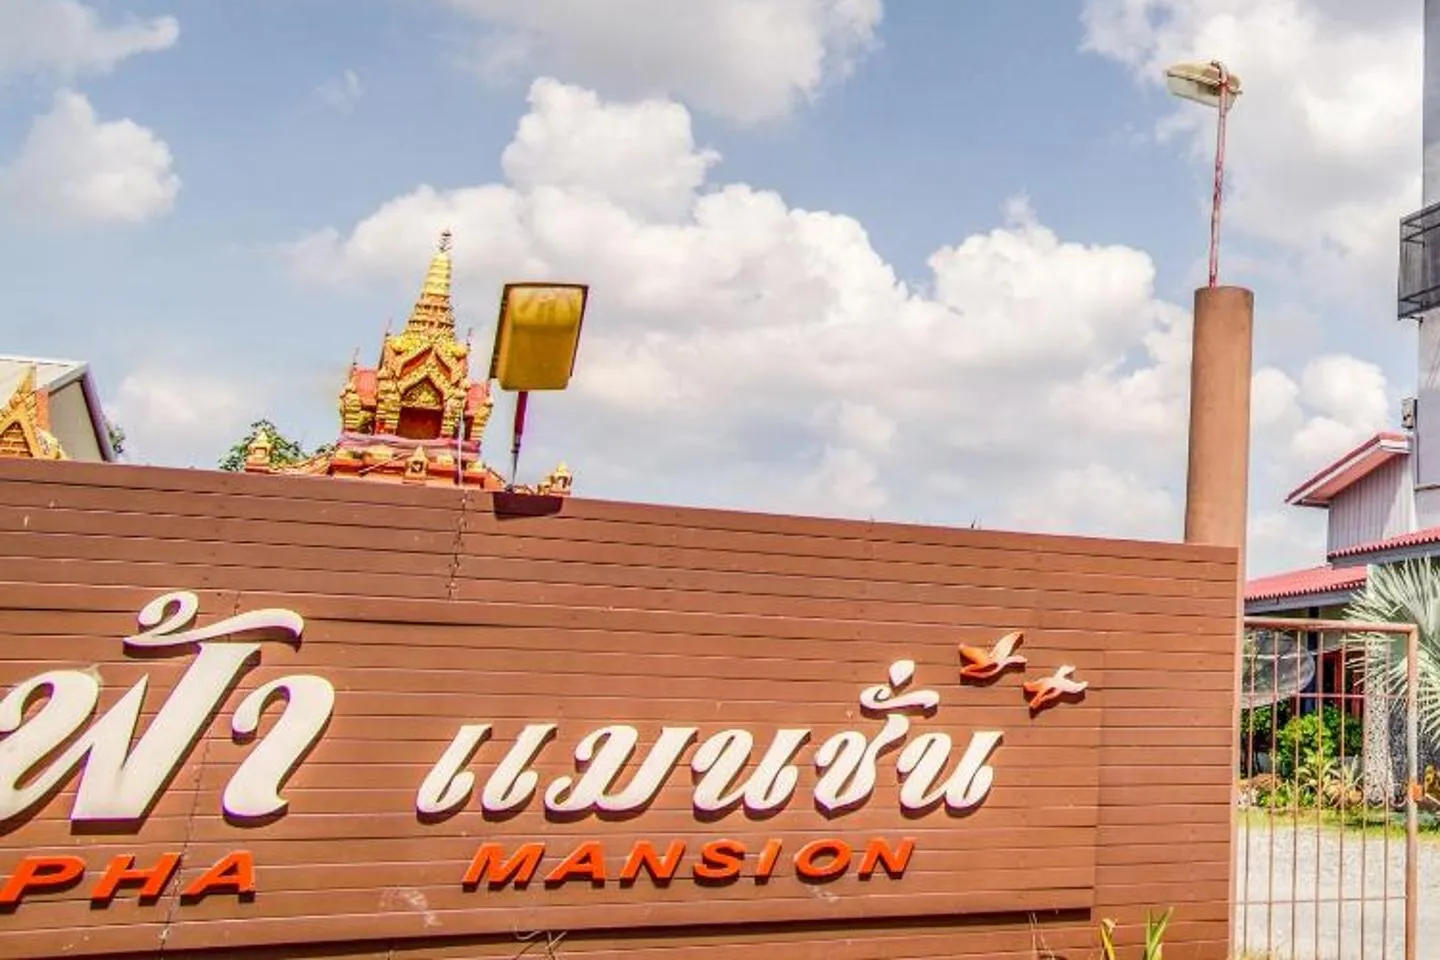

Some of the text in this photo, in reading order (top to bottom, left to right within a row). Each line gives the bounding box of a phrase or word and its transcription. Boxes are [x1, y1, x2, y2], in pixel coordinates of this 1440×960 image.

[416, 659, 1004, 817] แมนชั่น
[0, 836, 916, 908] PHA MANSION
